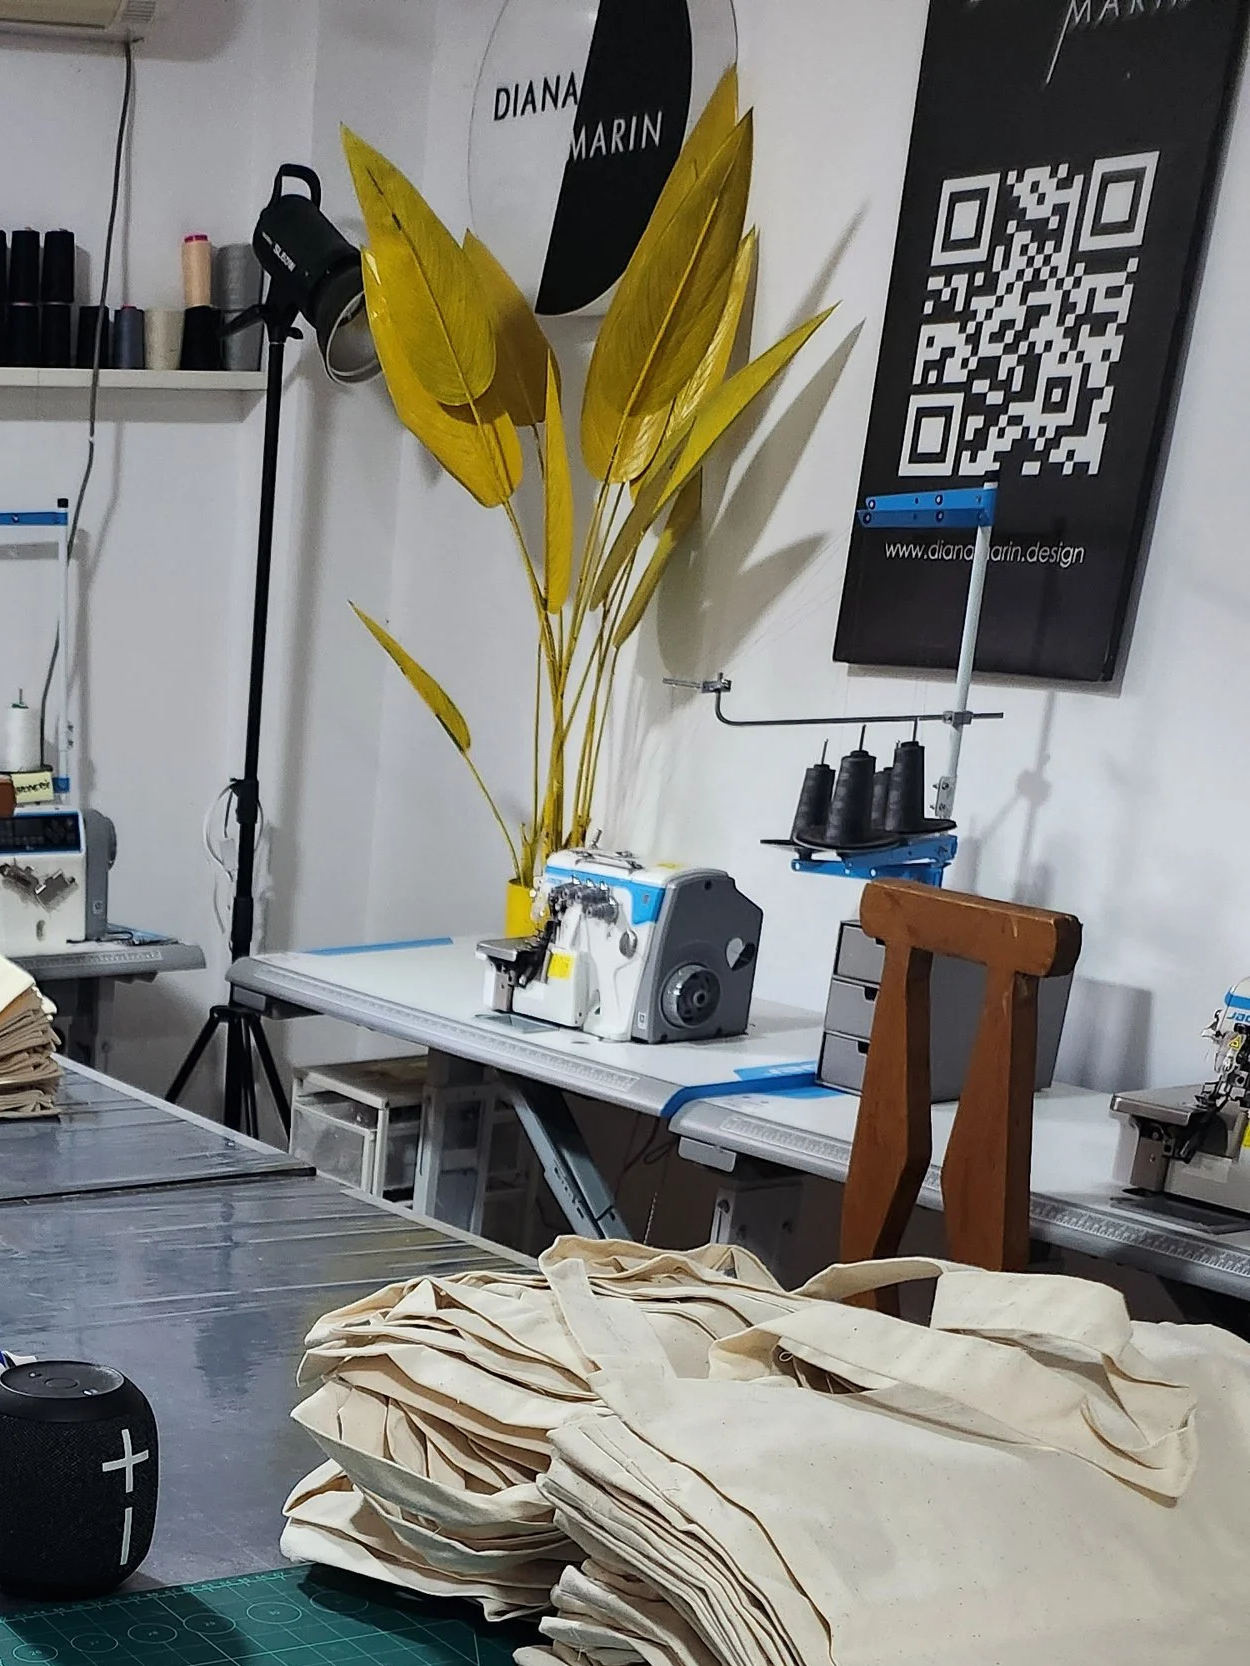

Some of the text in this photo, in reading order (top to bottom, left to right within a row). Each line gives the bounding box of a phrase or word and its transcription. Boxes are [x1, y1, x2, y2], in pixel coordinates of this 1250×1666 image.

[493, 71, 579, 121] DIANA
[570, 109, 663, 161] MARIN
[885, 540, 1085, 568] www.dianaarin.design
